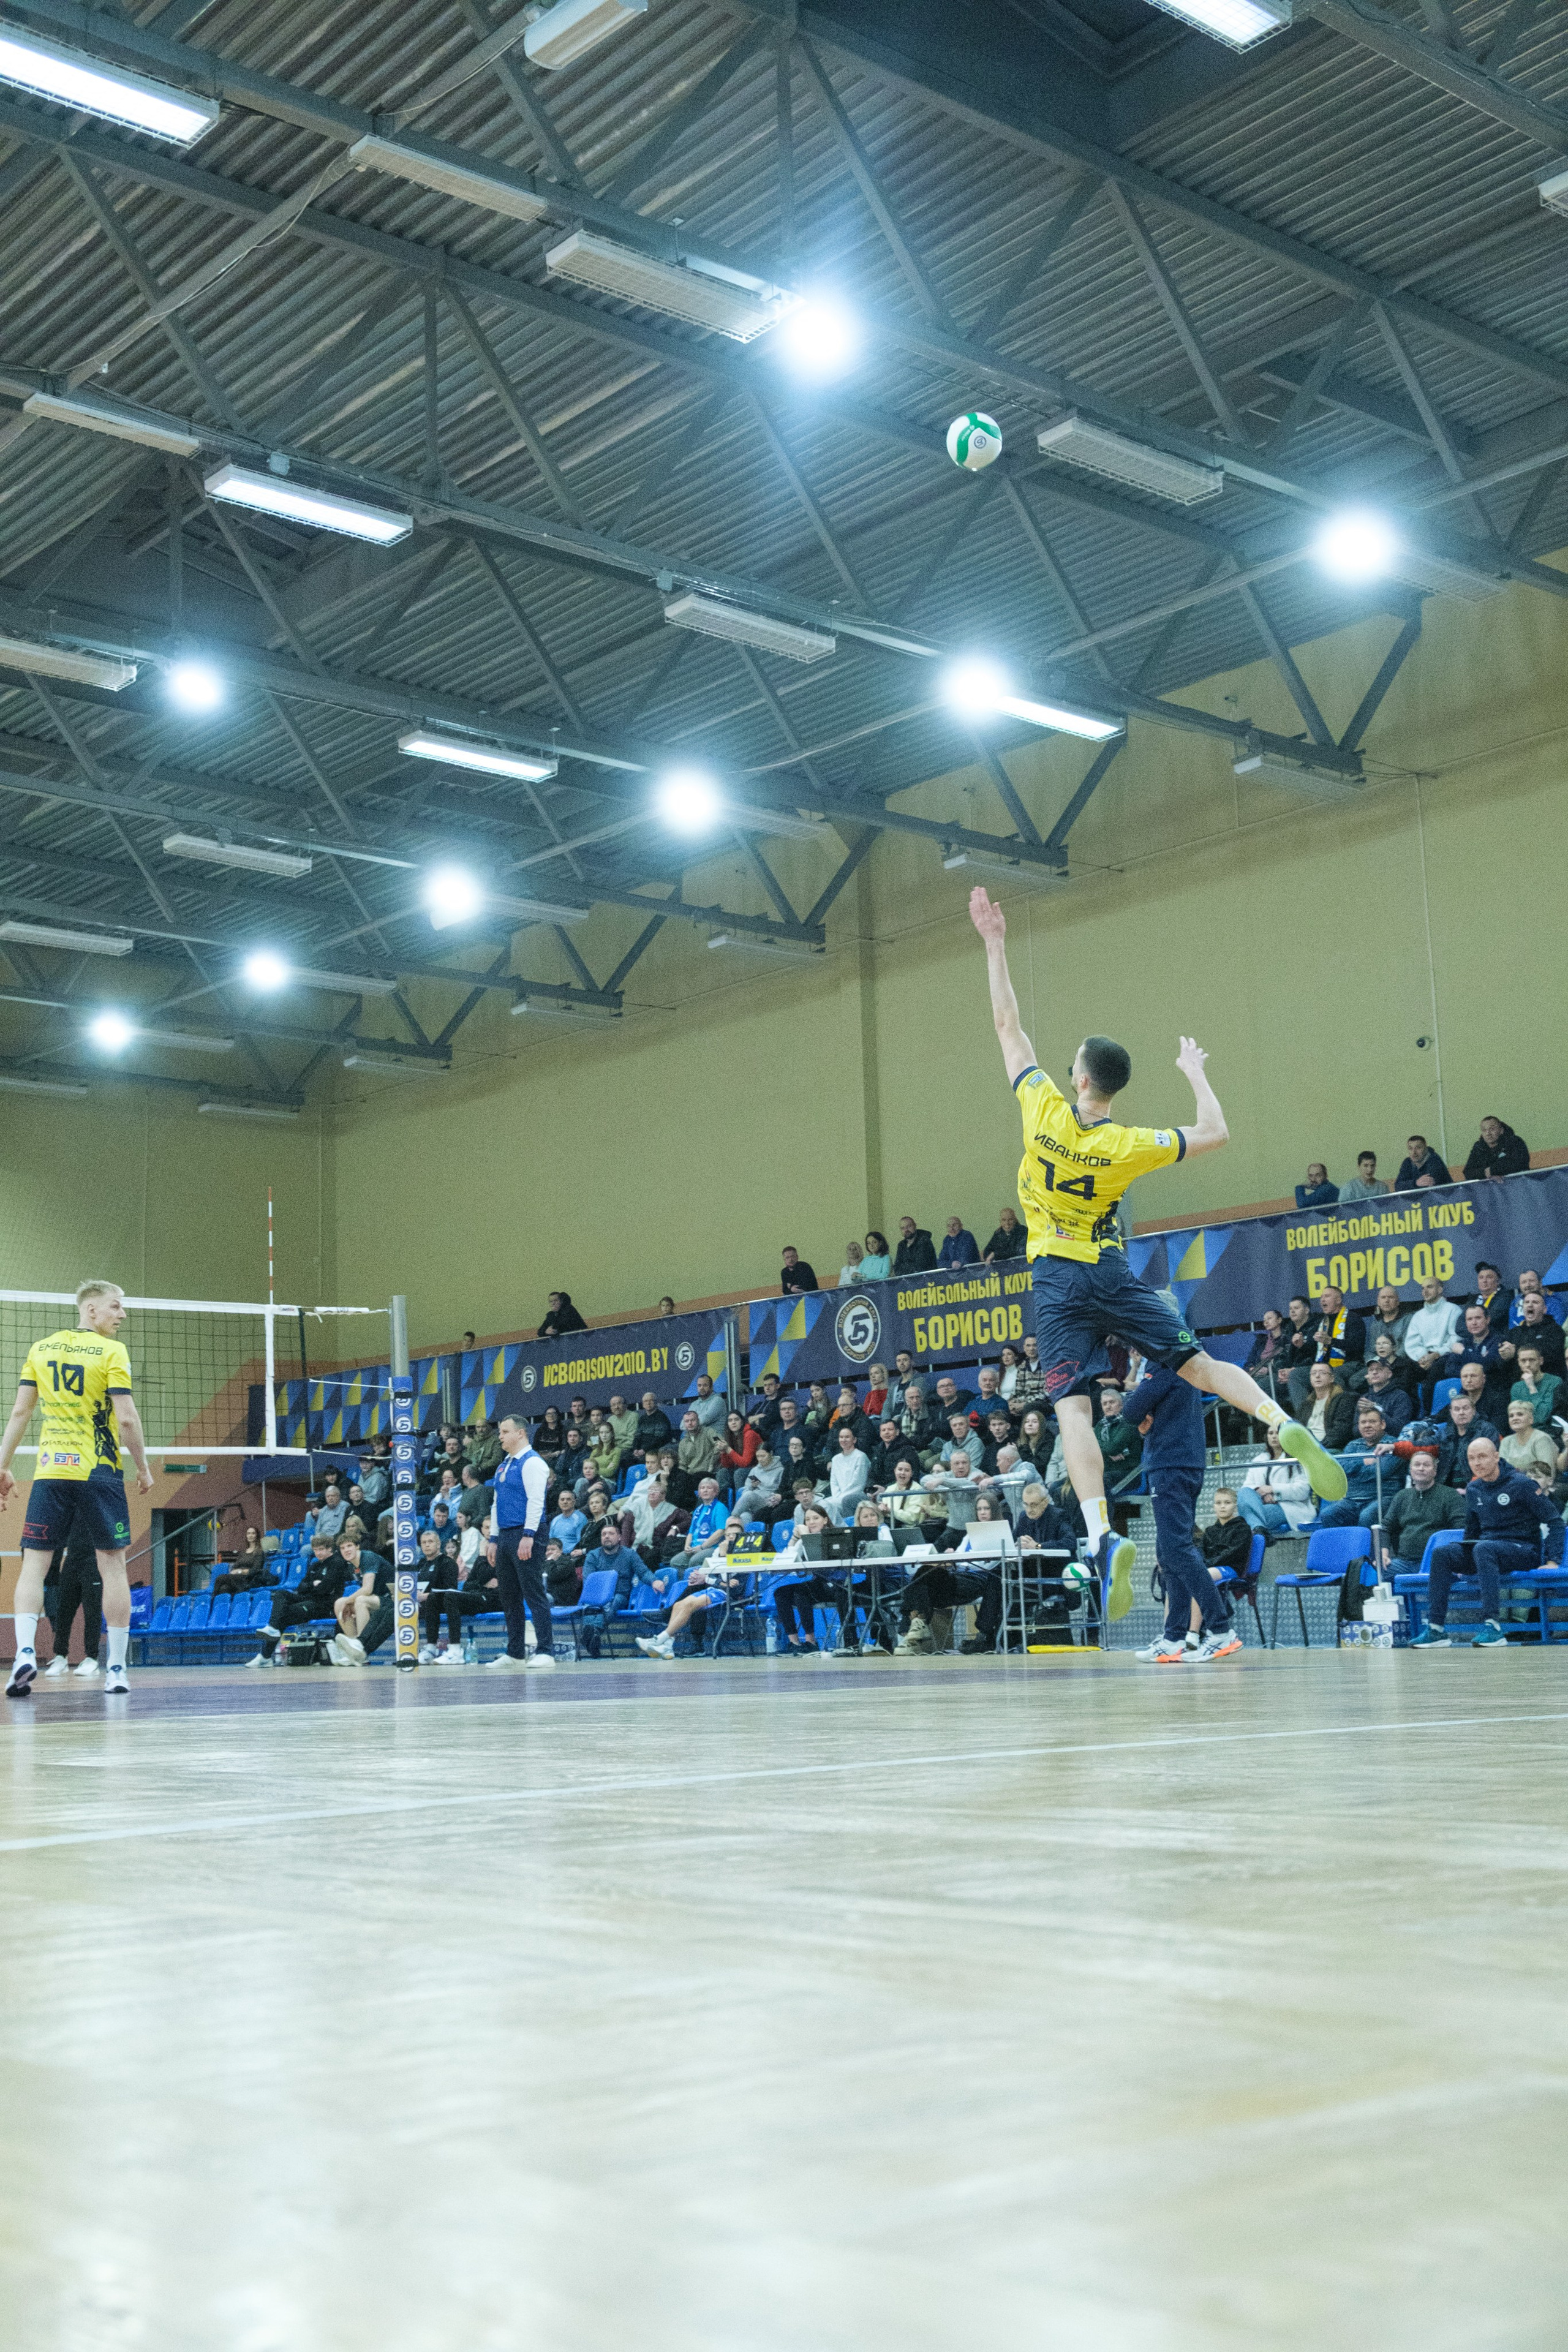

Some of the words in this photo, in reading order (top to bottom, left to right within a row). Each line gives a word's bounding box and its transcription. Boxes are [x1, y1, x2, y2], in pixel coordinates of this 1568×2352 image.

[1035, 1131, 1112, 1167] ИВАНКОВ
[1038, 1156, 1098, 1201] 14
[1286, 1202, 1423, 1251] ВОЛЕЙБОЛЬНЫЙ
[1428, 1200, 1475, 1230] КЛУБ
[1306, 1239, 1455, 1299] БОРИСОВ
[897, 1272, 1001, 1311] ВОЛЕЙБОЛЬНЫЙ
[914, 1304, 1023, 1353] БОРИСОВ
[39, 1342, 103, 1355] ЕМЕЛЬЯНОВ
[543, 1347, 669, 1387] VCBORISOV2010.BY
[47, 1360, 85, 1396] 10
[736, 1536, 745, 1548] 4
[753, 1535, 763, 1547] 4
